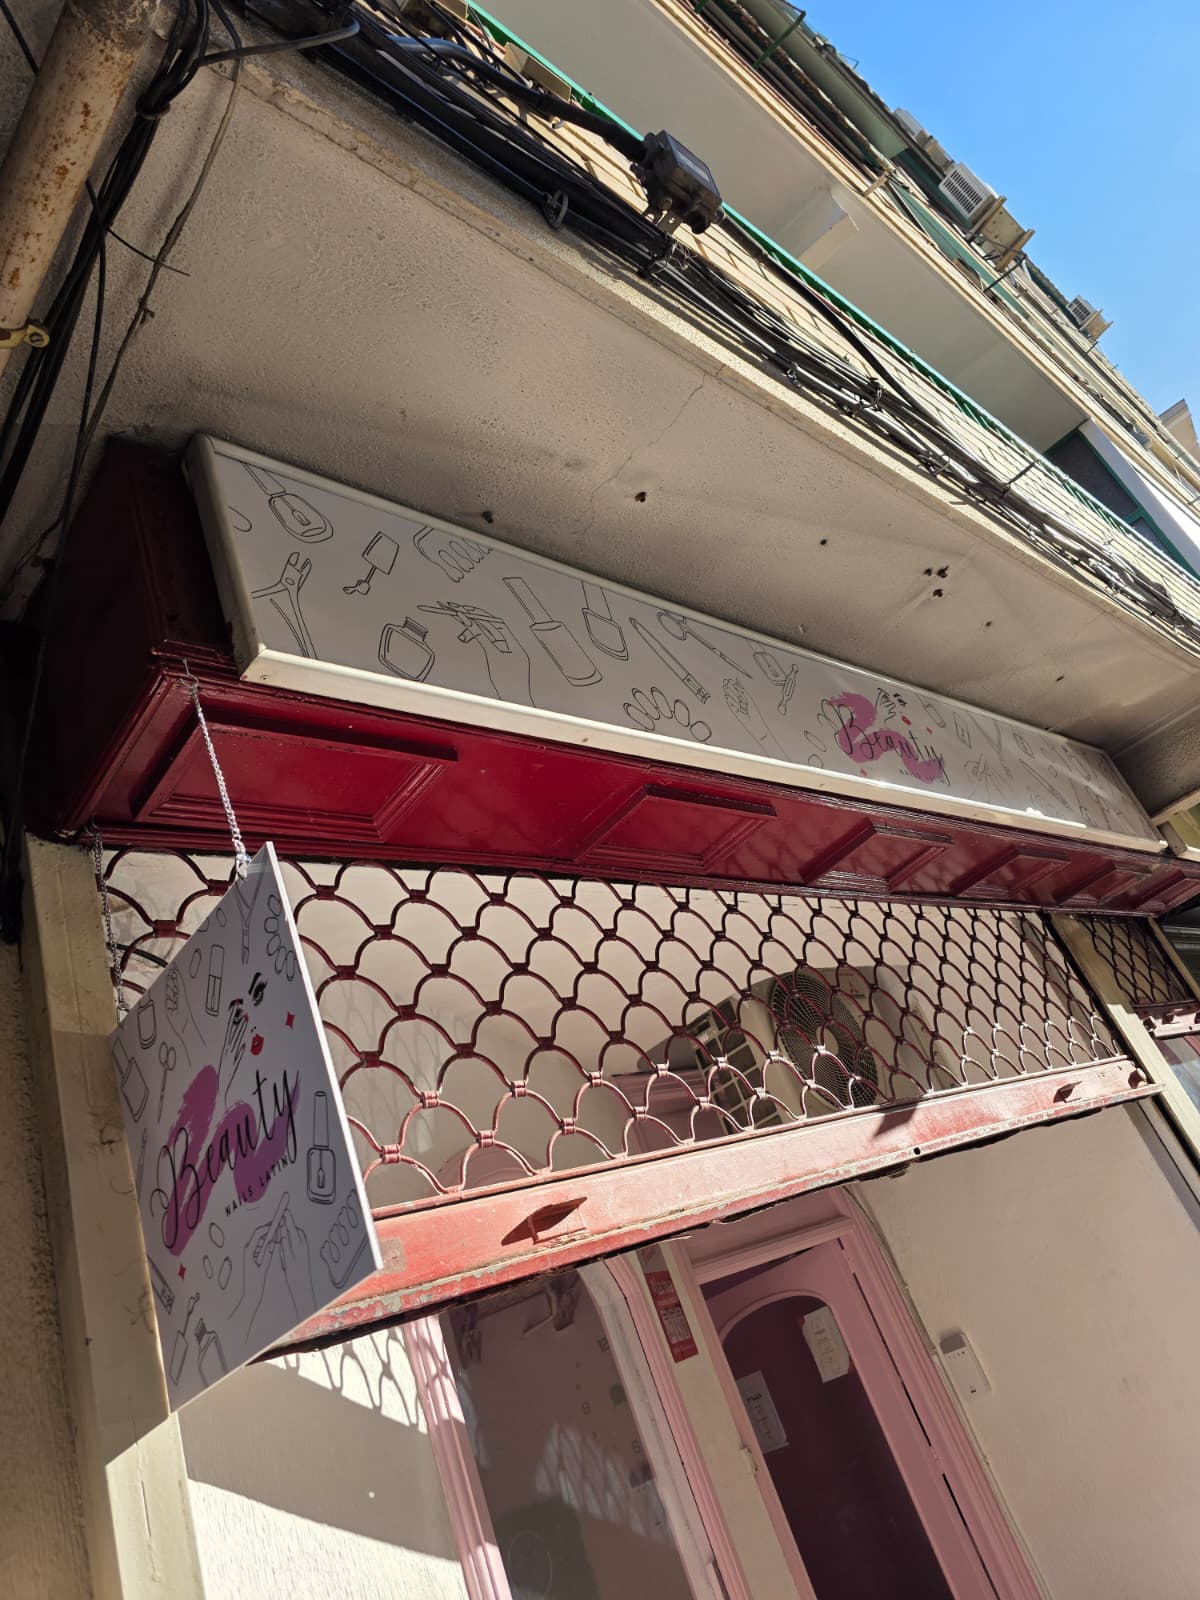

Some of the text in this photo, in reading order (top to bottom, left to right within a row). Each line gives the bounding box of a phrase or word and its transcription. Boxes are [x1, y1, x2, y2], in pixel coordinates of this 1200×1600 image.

[817, 699, 951, 786] Beauty
[151, 1069, 300, 1249] Beauty
[225, 1184, 254, 1217] NAILS
